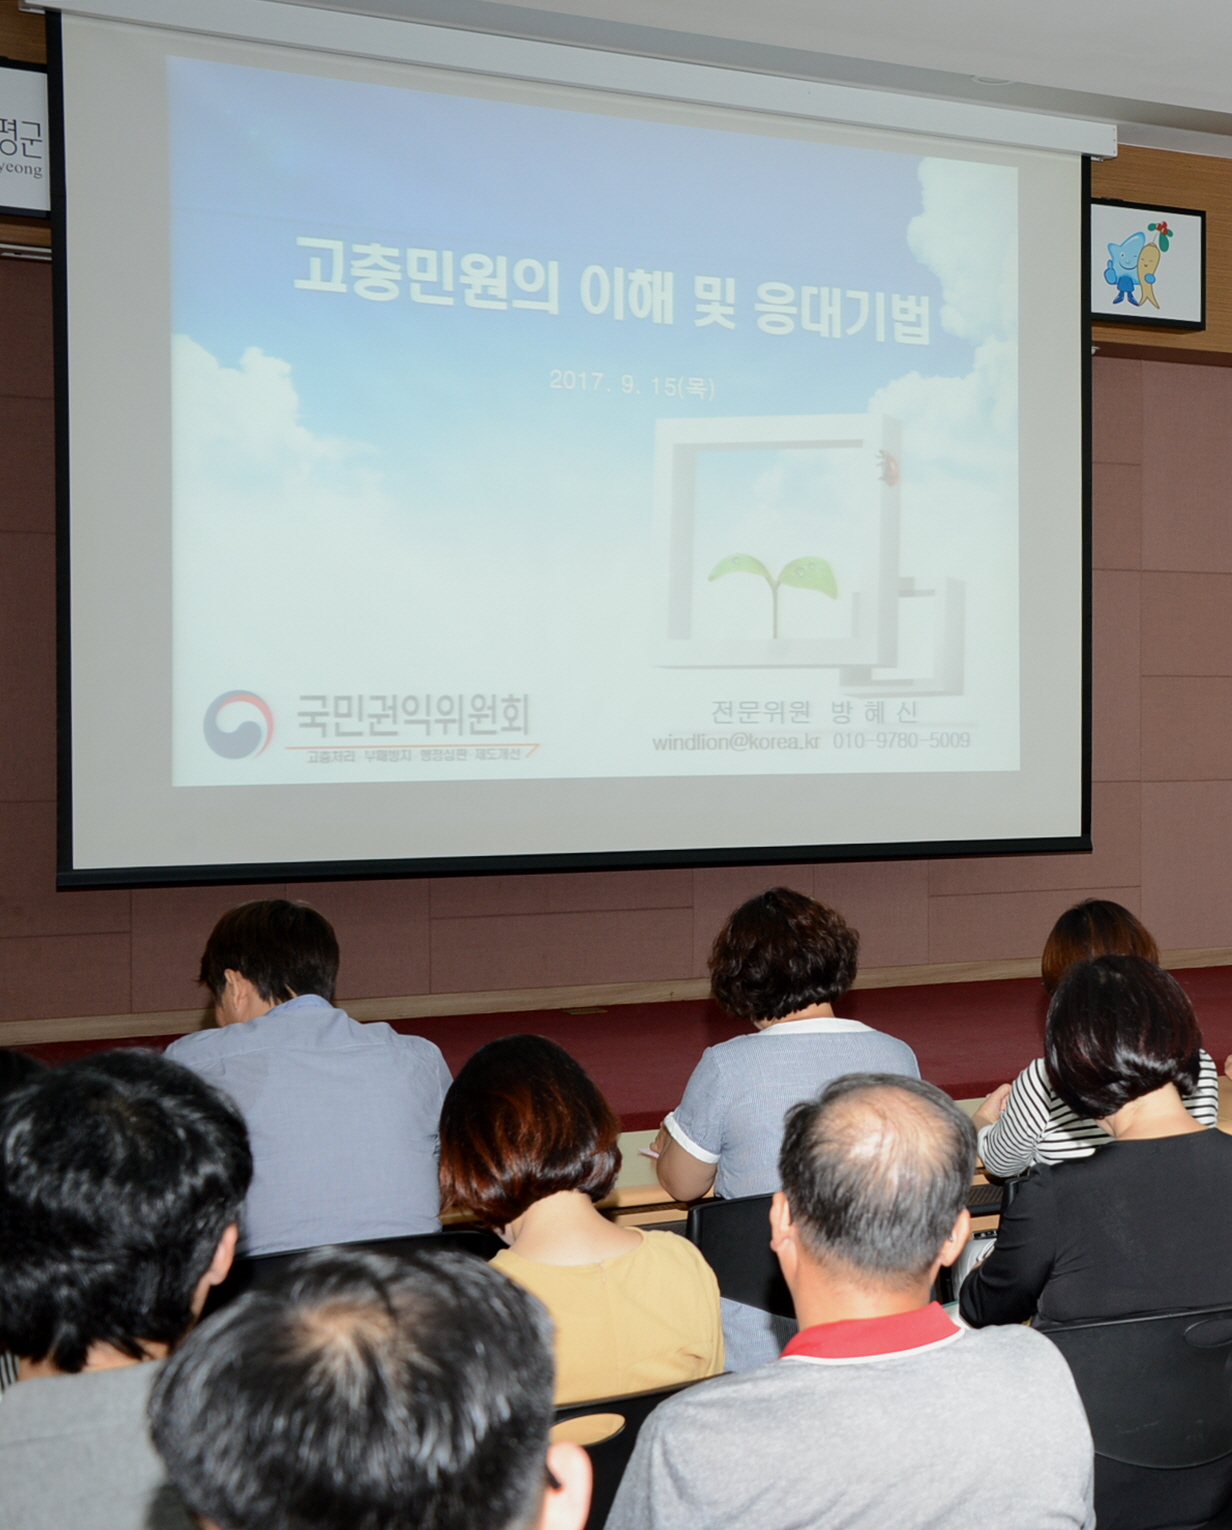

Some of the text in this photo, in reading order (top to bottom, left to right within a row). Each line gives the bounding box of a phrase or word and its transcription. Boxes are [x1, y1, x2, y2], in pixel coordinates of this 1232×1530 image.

[293, 236, 931, 345] 고충민원의 이해 및 응대기법
[549, 369, 715, 401] 2017. 9. 15(목)
[297, 693, 529, 738] 국민권익위원회
[711, 699, 918, 725] 전문위원 방 혜 신
[652, 731, 970, 752] windlion@korea.kr 010-9780-5009
